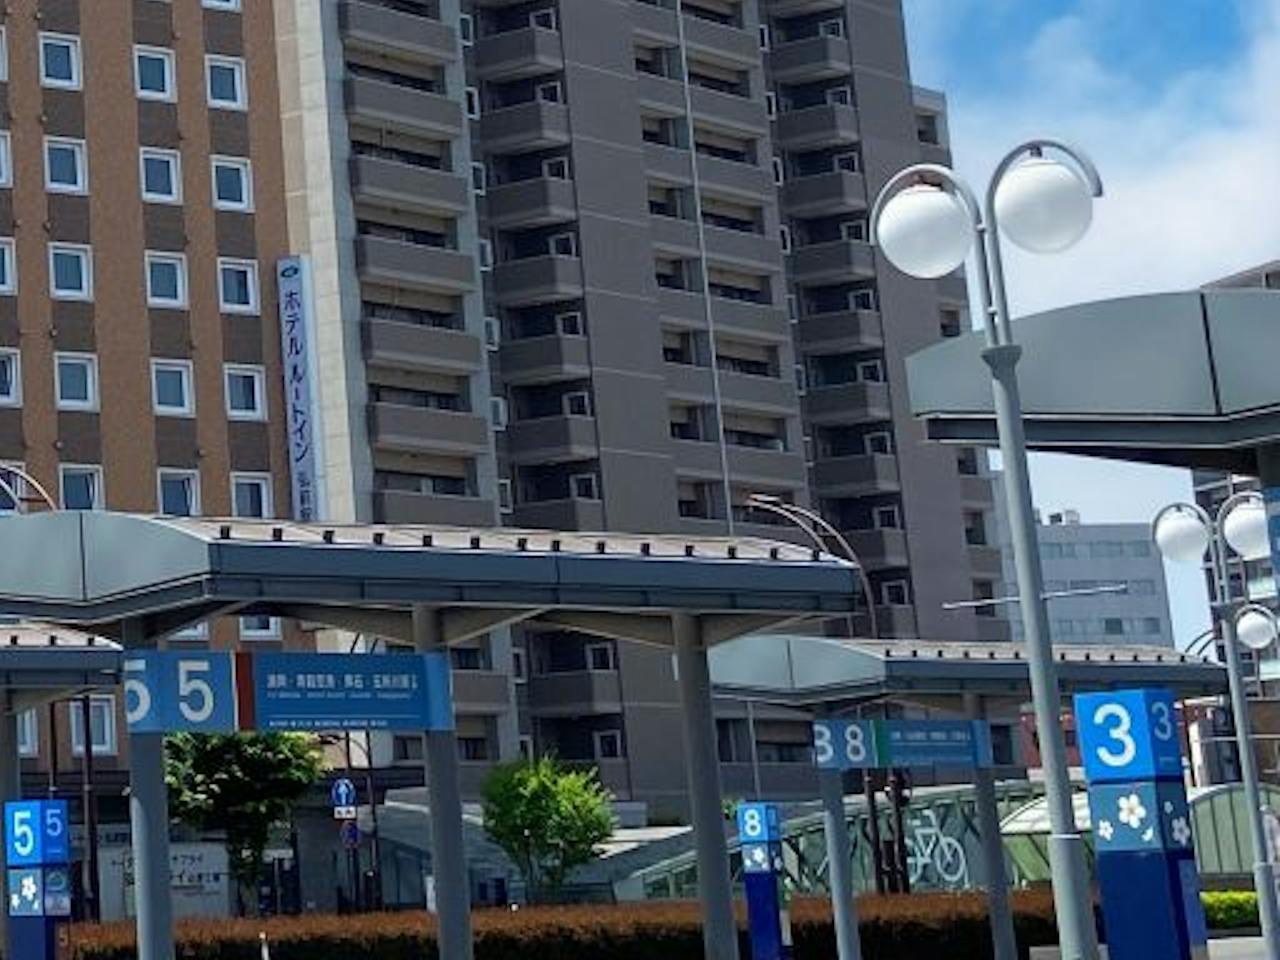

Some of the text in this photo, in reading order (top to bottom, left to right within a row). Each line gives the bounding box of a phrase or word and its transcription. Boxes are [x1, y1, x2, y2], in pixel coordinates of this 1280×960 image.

[283, 292, 303, 356] ホテル
[289, 364, 309, 464] ルートイン
[178, 660, 215, 722] 5
[844, 724, 866, 762] 8
[1093, 703, 1136, 767] 3
[1152, 701, 1172, 741] 3
[13, 810, 35, 857] 5
[46, 808, 63, 837] 5
[743, 808, 762, 836] 8
